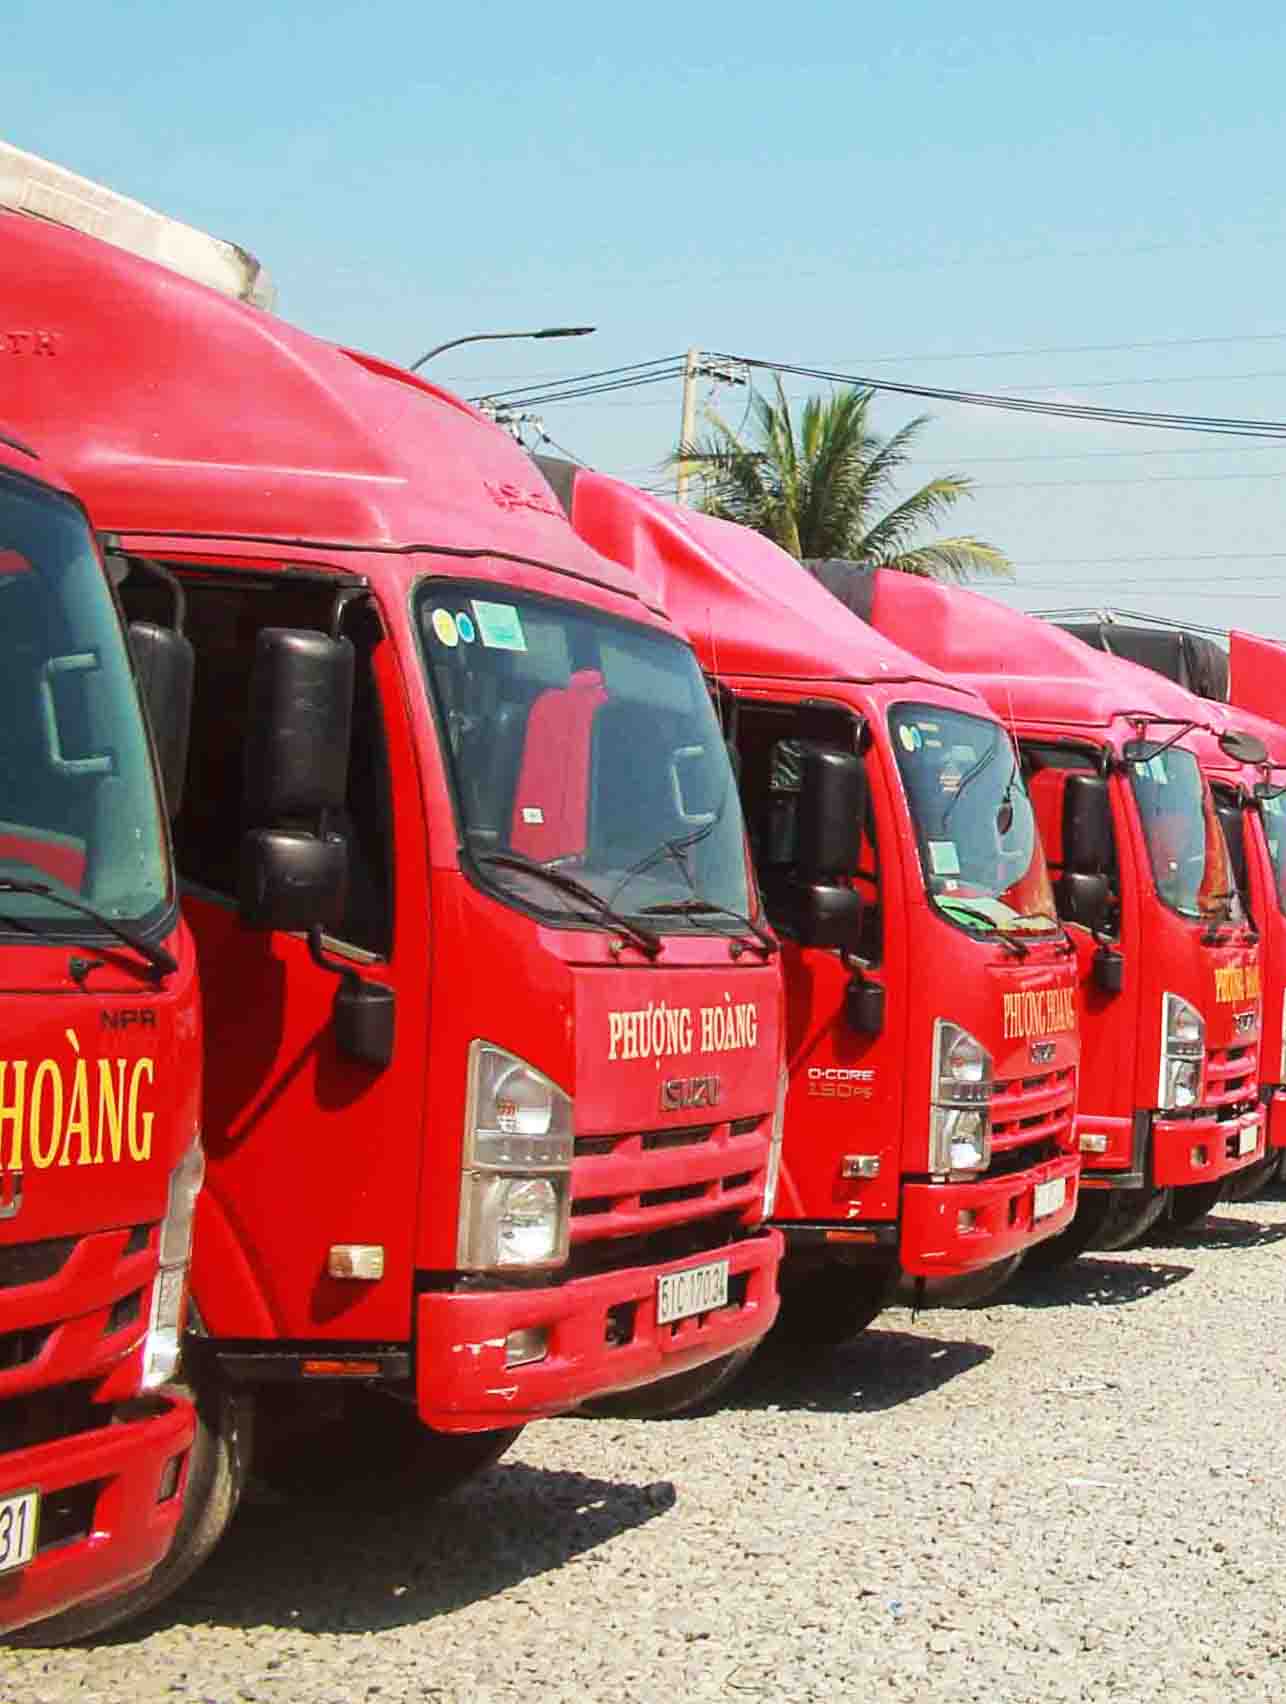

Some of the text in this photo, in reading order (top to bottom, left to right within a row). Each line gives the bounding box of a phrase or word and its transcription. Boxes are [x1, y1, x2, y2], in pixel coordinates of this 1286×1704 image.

[608, 991, 758, 1071] PHƯỢNG HOÀNG
[0, 1028, 155, 1169] HOÀNG
